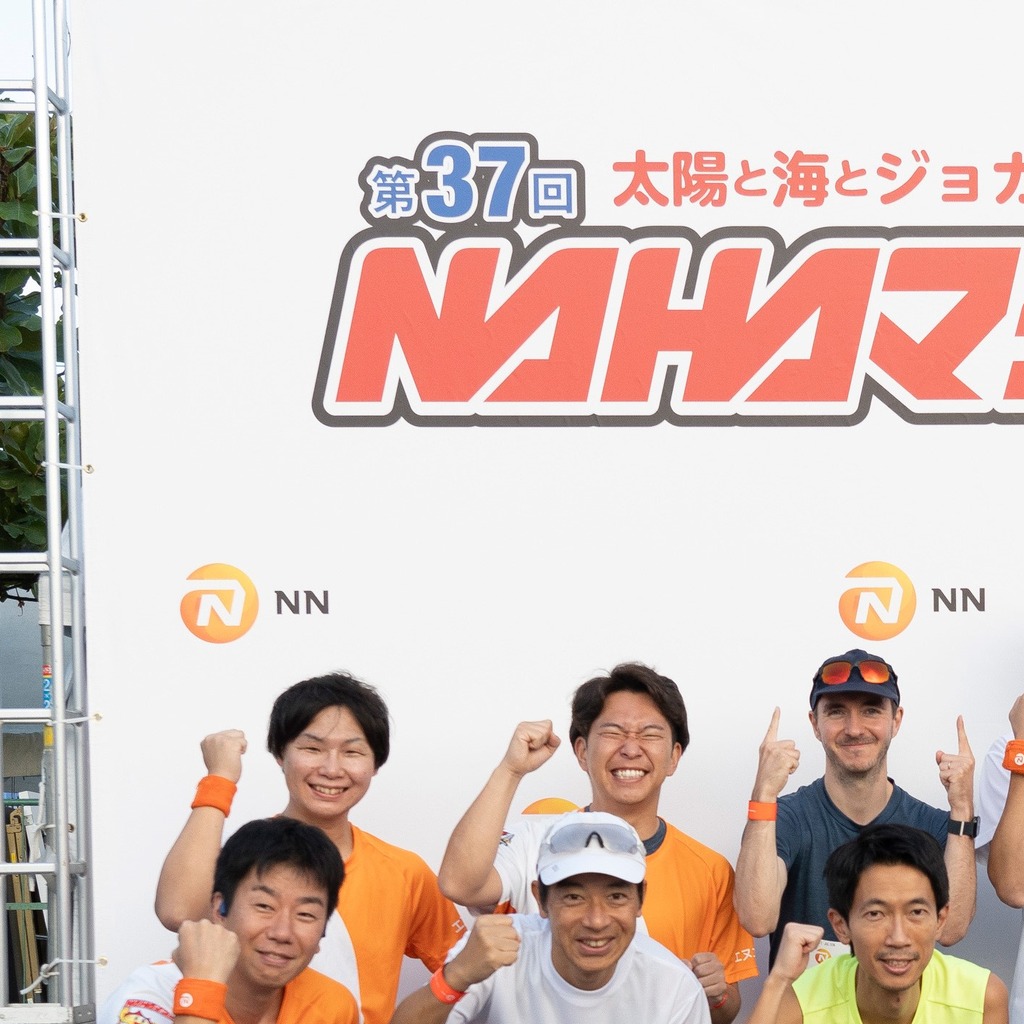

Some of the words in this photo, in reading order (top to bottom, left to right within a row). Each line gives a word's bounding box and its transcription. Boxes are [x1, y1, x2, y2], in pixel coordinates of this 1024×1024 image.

[371, 144, 575, 221] 第37回
[274, 590, 329, 615] NN
[931, 587, 986, 612] NN
